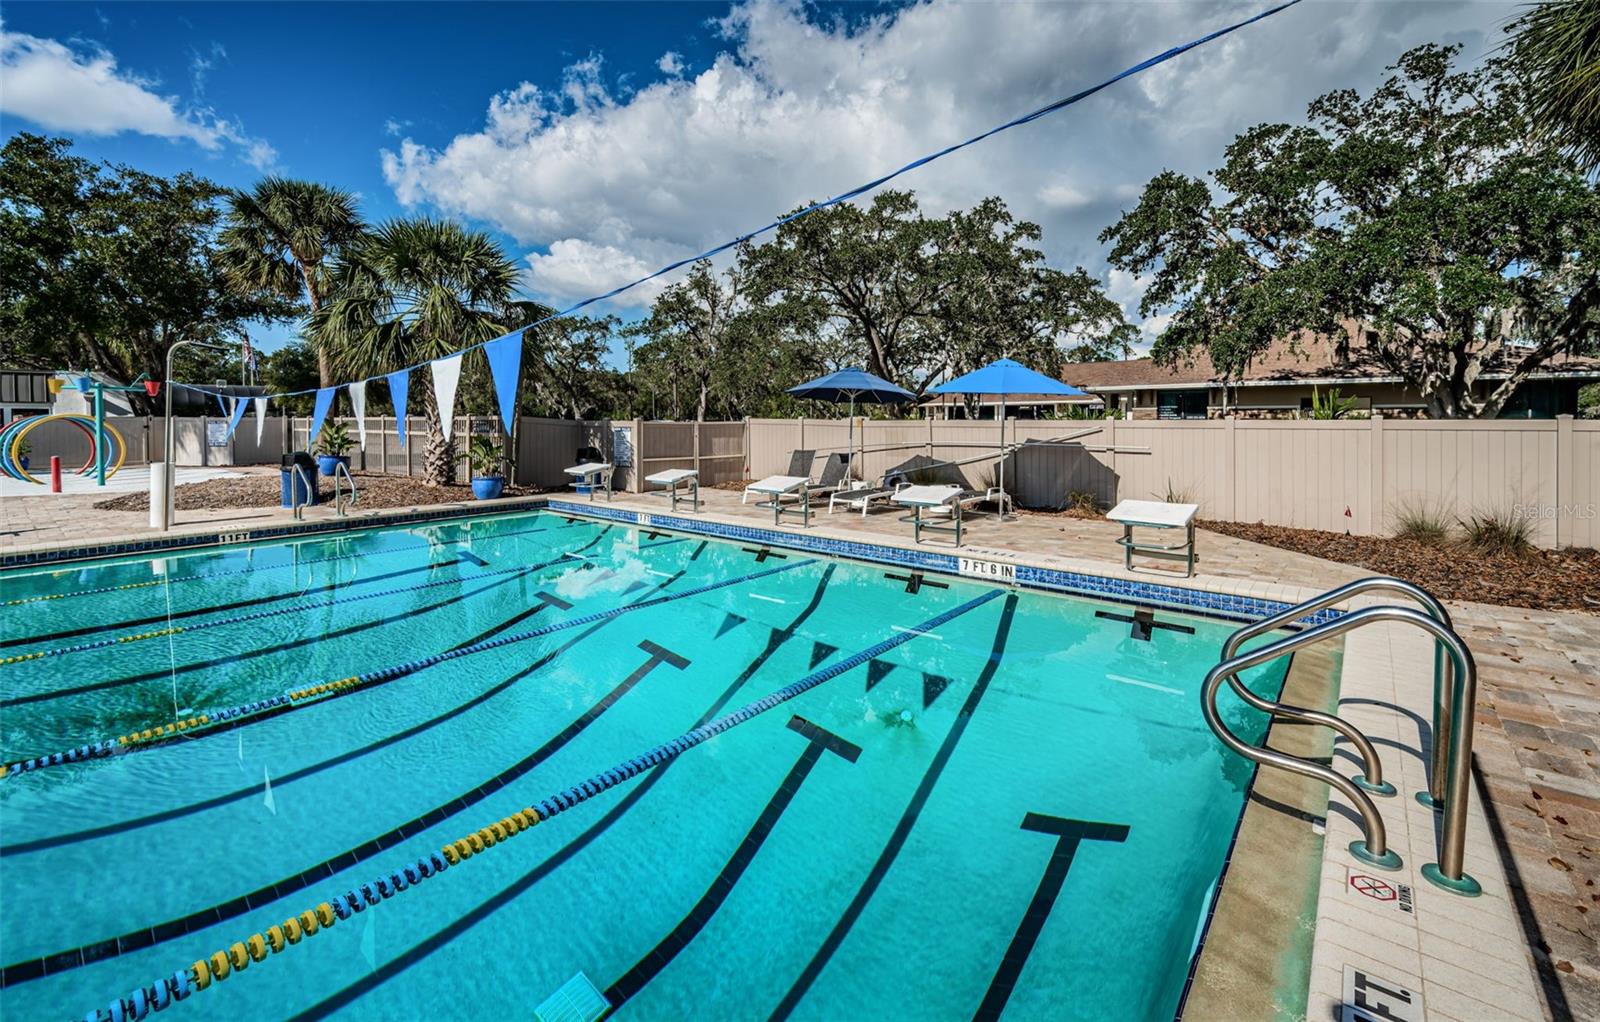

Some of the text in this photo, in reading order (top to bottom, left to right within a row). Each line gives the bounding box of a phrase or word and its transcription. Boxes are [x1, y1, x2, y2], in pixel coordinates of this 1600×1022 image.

[963, 560, 968, 570] 7
[990, 564, 997, 575] 6
[1001, 565, 1013, 577] IN
[1399, 902, 1413, 914] NO
[1354, 971, 1411, 1022] FT.
